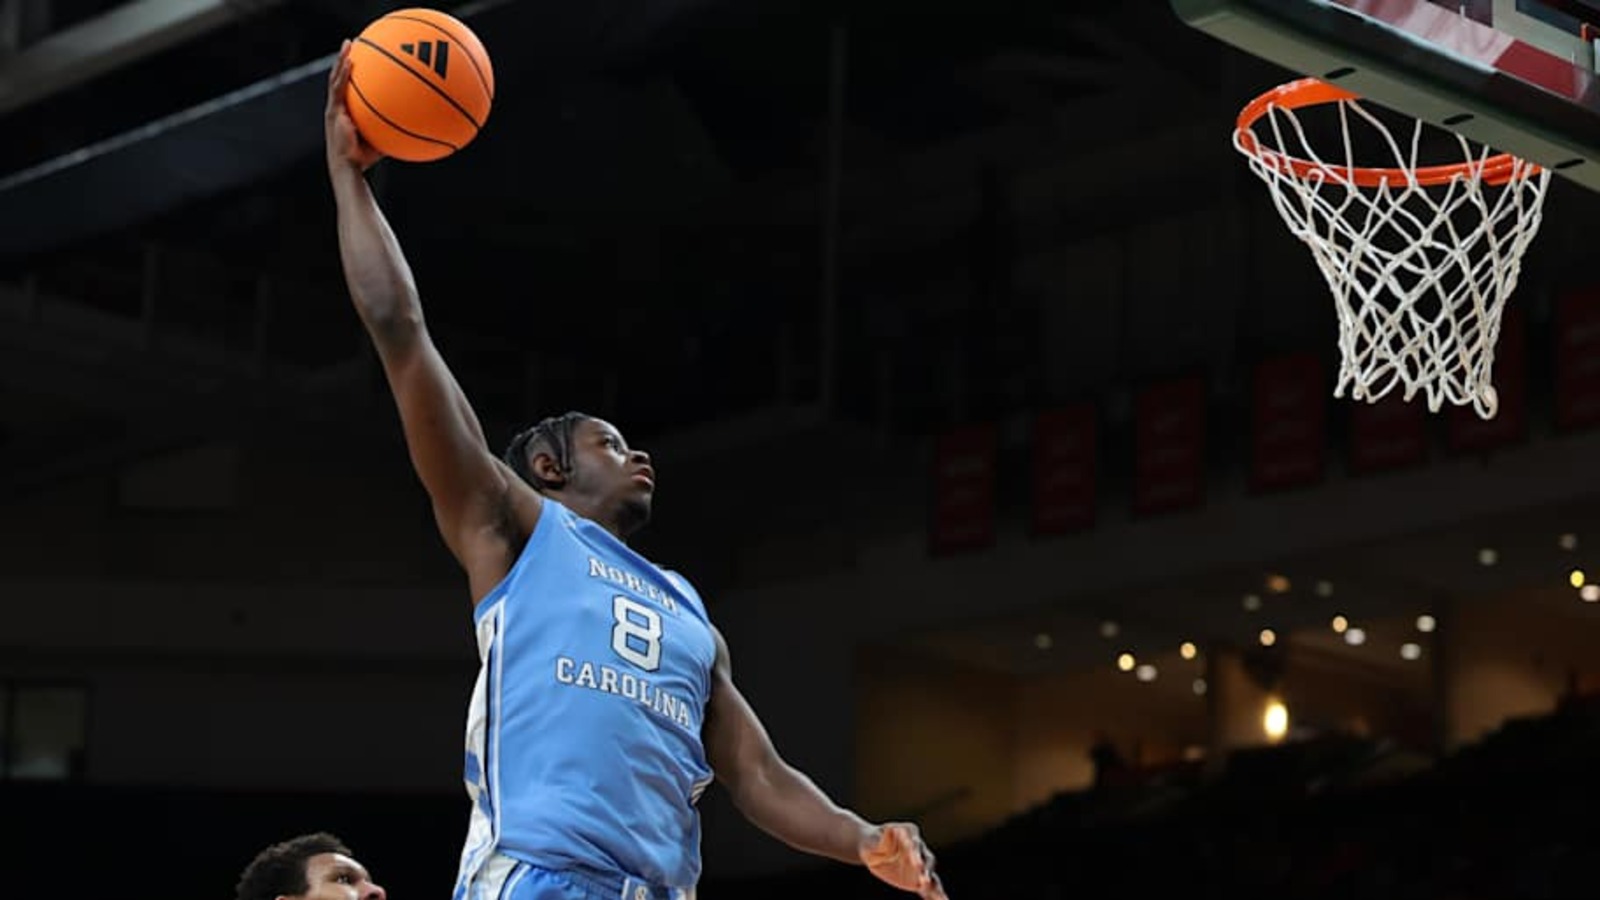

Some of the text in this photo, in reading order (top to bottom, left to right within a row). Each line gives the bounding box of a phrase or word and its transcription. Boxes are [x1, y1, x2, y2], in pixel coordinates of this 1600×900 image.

[588, 556, 679, 615] NORTH
[611, 594, 663, 672] 8
[555, 657, 691, 728] CAROLINA
